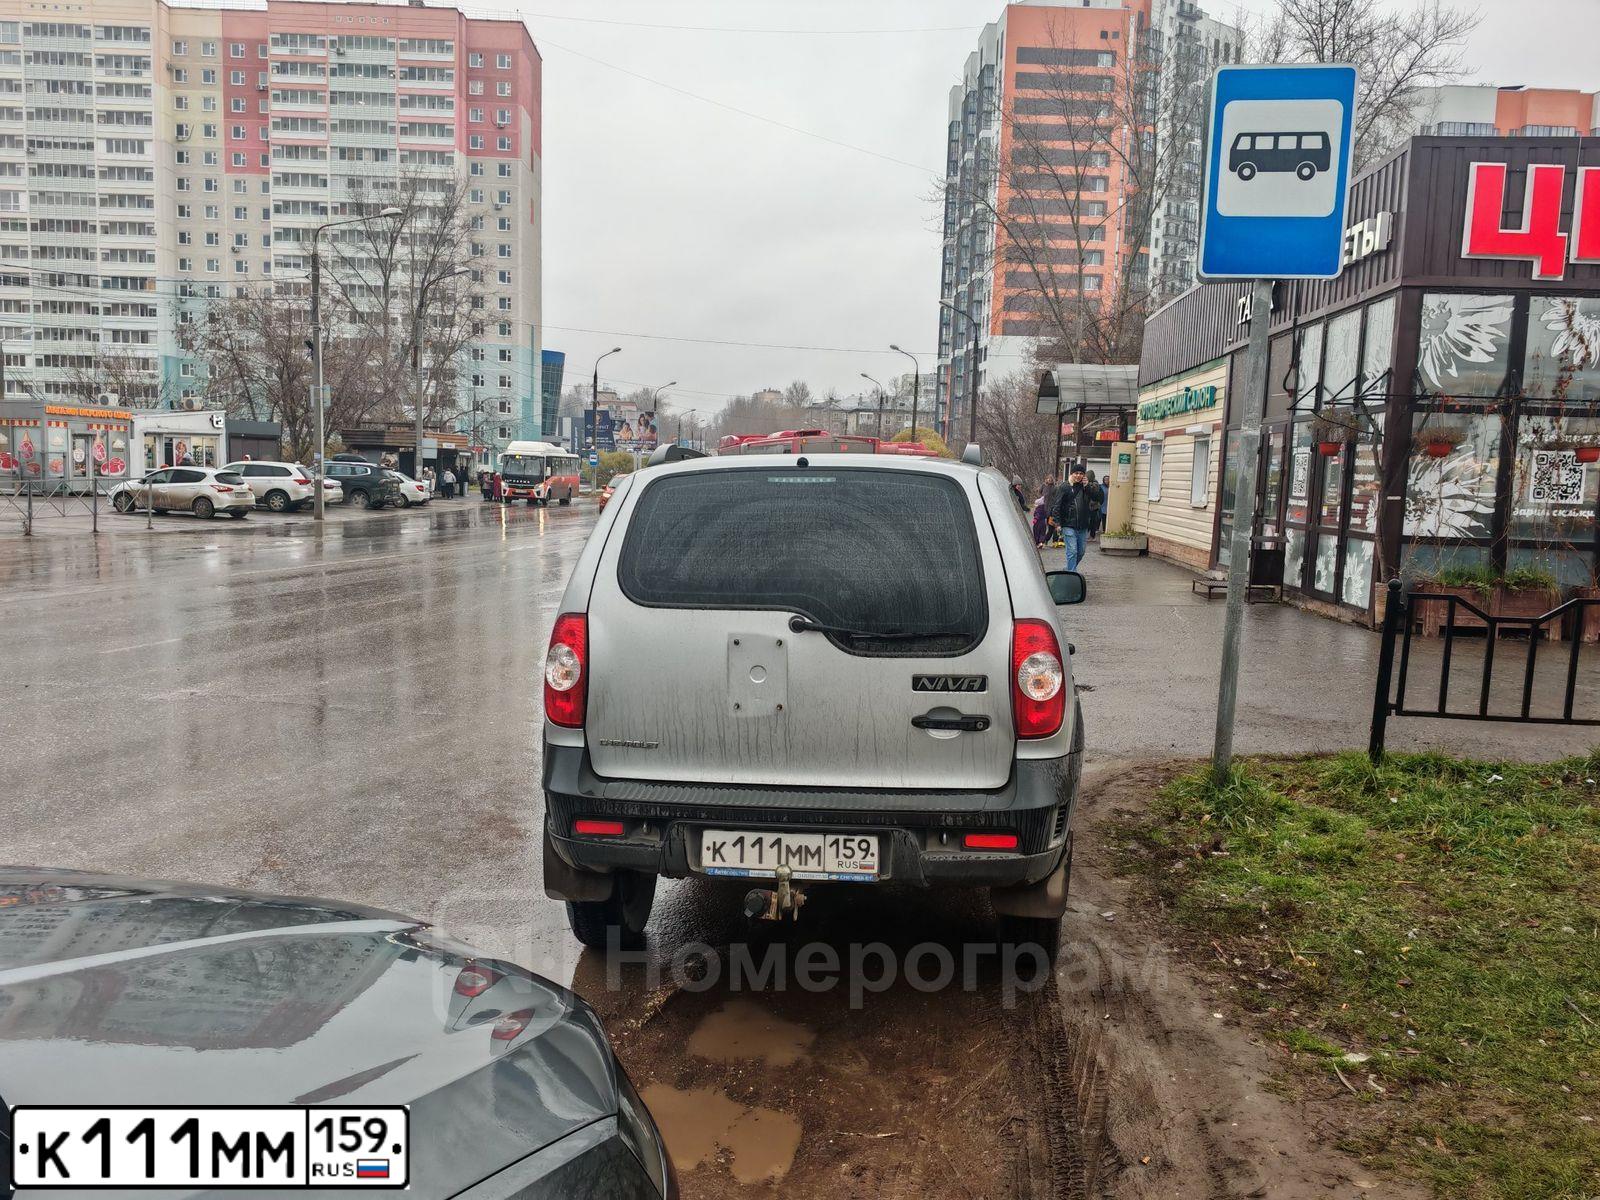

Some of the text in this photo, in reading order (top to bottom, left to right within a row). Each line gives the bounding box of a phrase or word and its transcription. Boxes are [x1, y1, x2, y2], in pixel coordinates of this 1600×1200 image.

[1188, 385, 1216, 409] САЛОН
[916, 676, 983, 691] NIVA
[828, 837, 872, 860] 159
[837, 860, 859, 869] RUS
